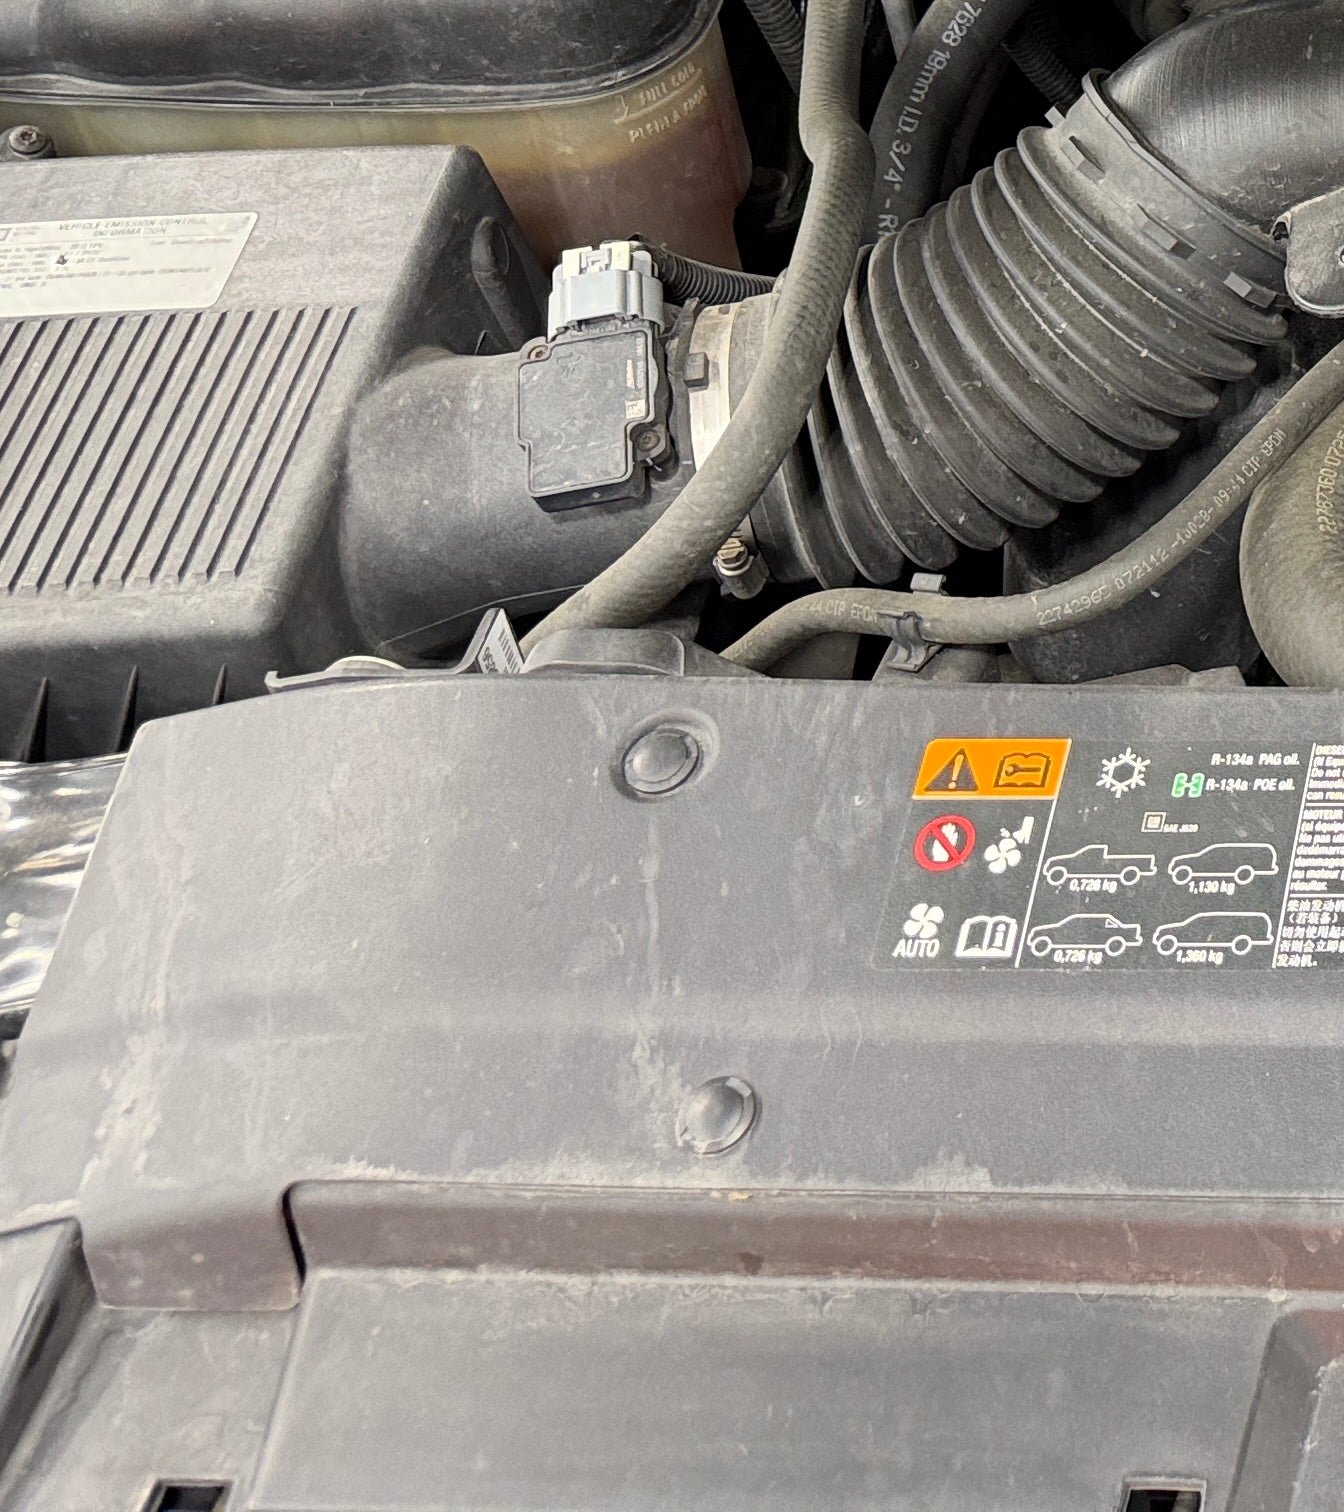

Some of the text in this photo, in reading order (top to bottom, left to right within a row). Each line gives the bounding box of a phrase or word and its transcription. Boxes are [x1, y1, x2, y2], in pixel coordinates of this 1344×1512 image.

[942, 1, 981, 48] 7628
[911, 48, 952, 103] 19mm
[104, 218, 157, 230] EMISSION
[1211, 753, 1300, 765] R-134a PAG oil.
[1205, 778, 1295, 792] R-134a POE oil.
[1102, 879, 1117, 893] kg
[1220, 879, 1236, 895] kg
[891, 937, 941, 960] AUTO
[1085, 950, 1103, 965] kg
[1208, 949, 1225, 966] kg
